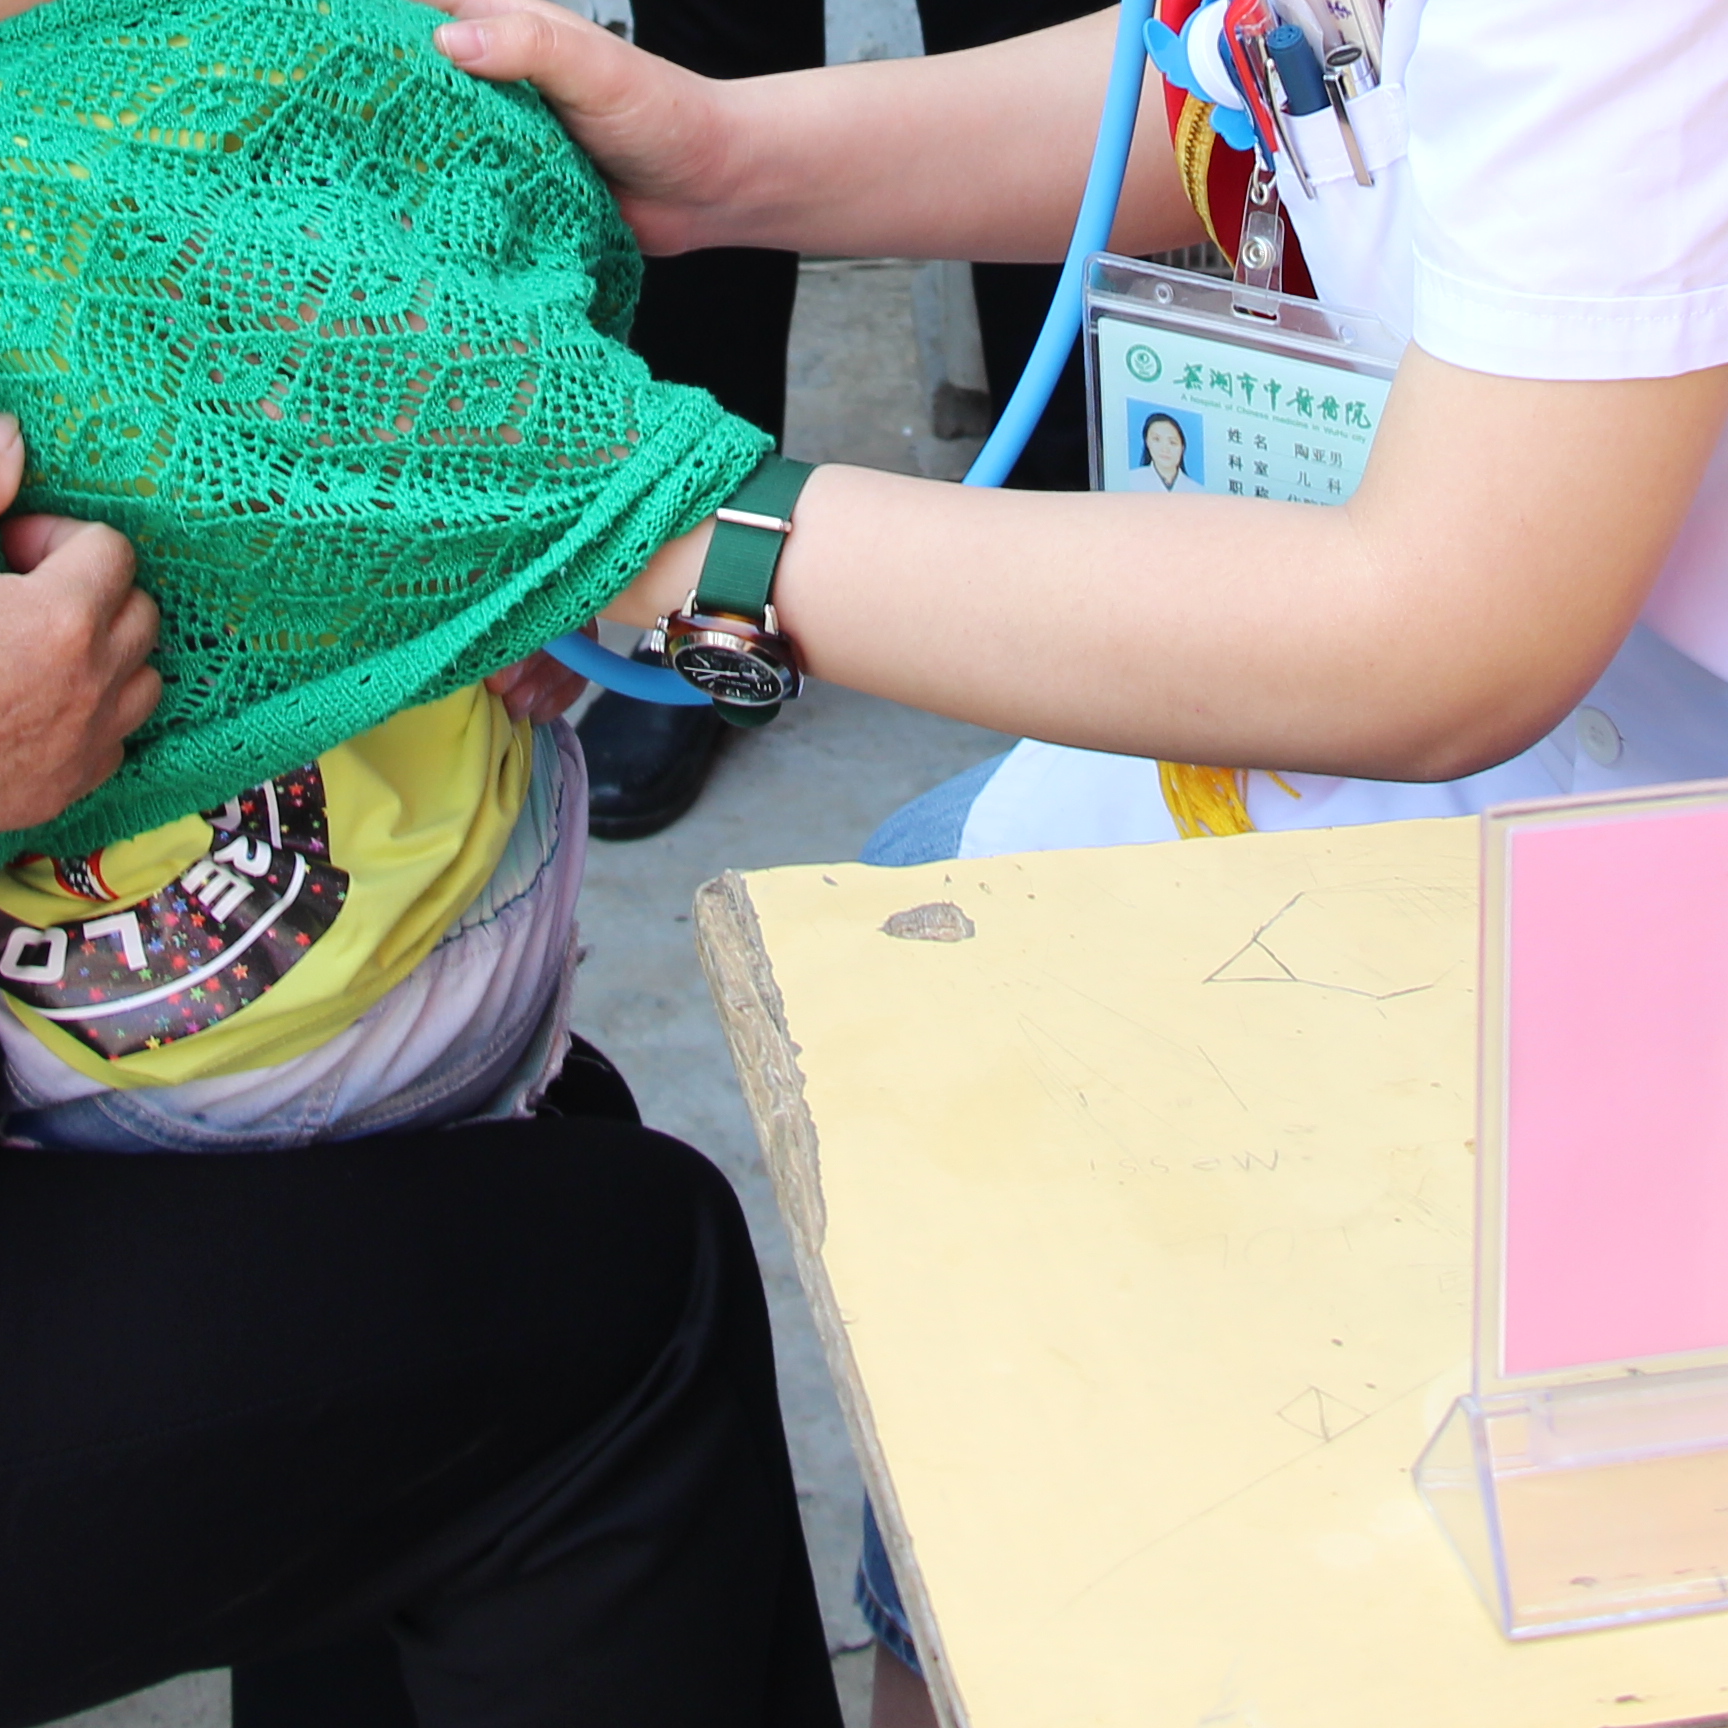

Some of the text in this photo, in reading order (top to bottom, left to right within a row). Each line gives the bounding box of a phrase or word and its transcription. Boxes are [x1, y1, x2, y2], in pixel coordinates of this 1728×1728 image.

[1189, 394, 1223, 410] hospital
[1236, 405, 1270, 421] Chinese
[1294, 442, 1343, 469] 陶亚男
